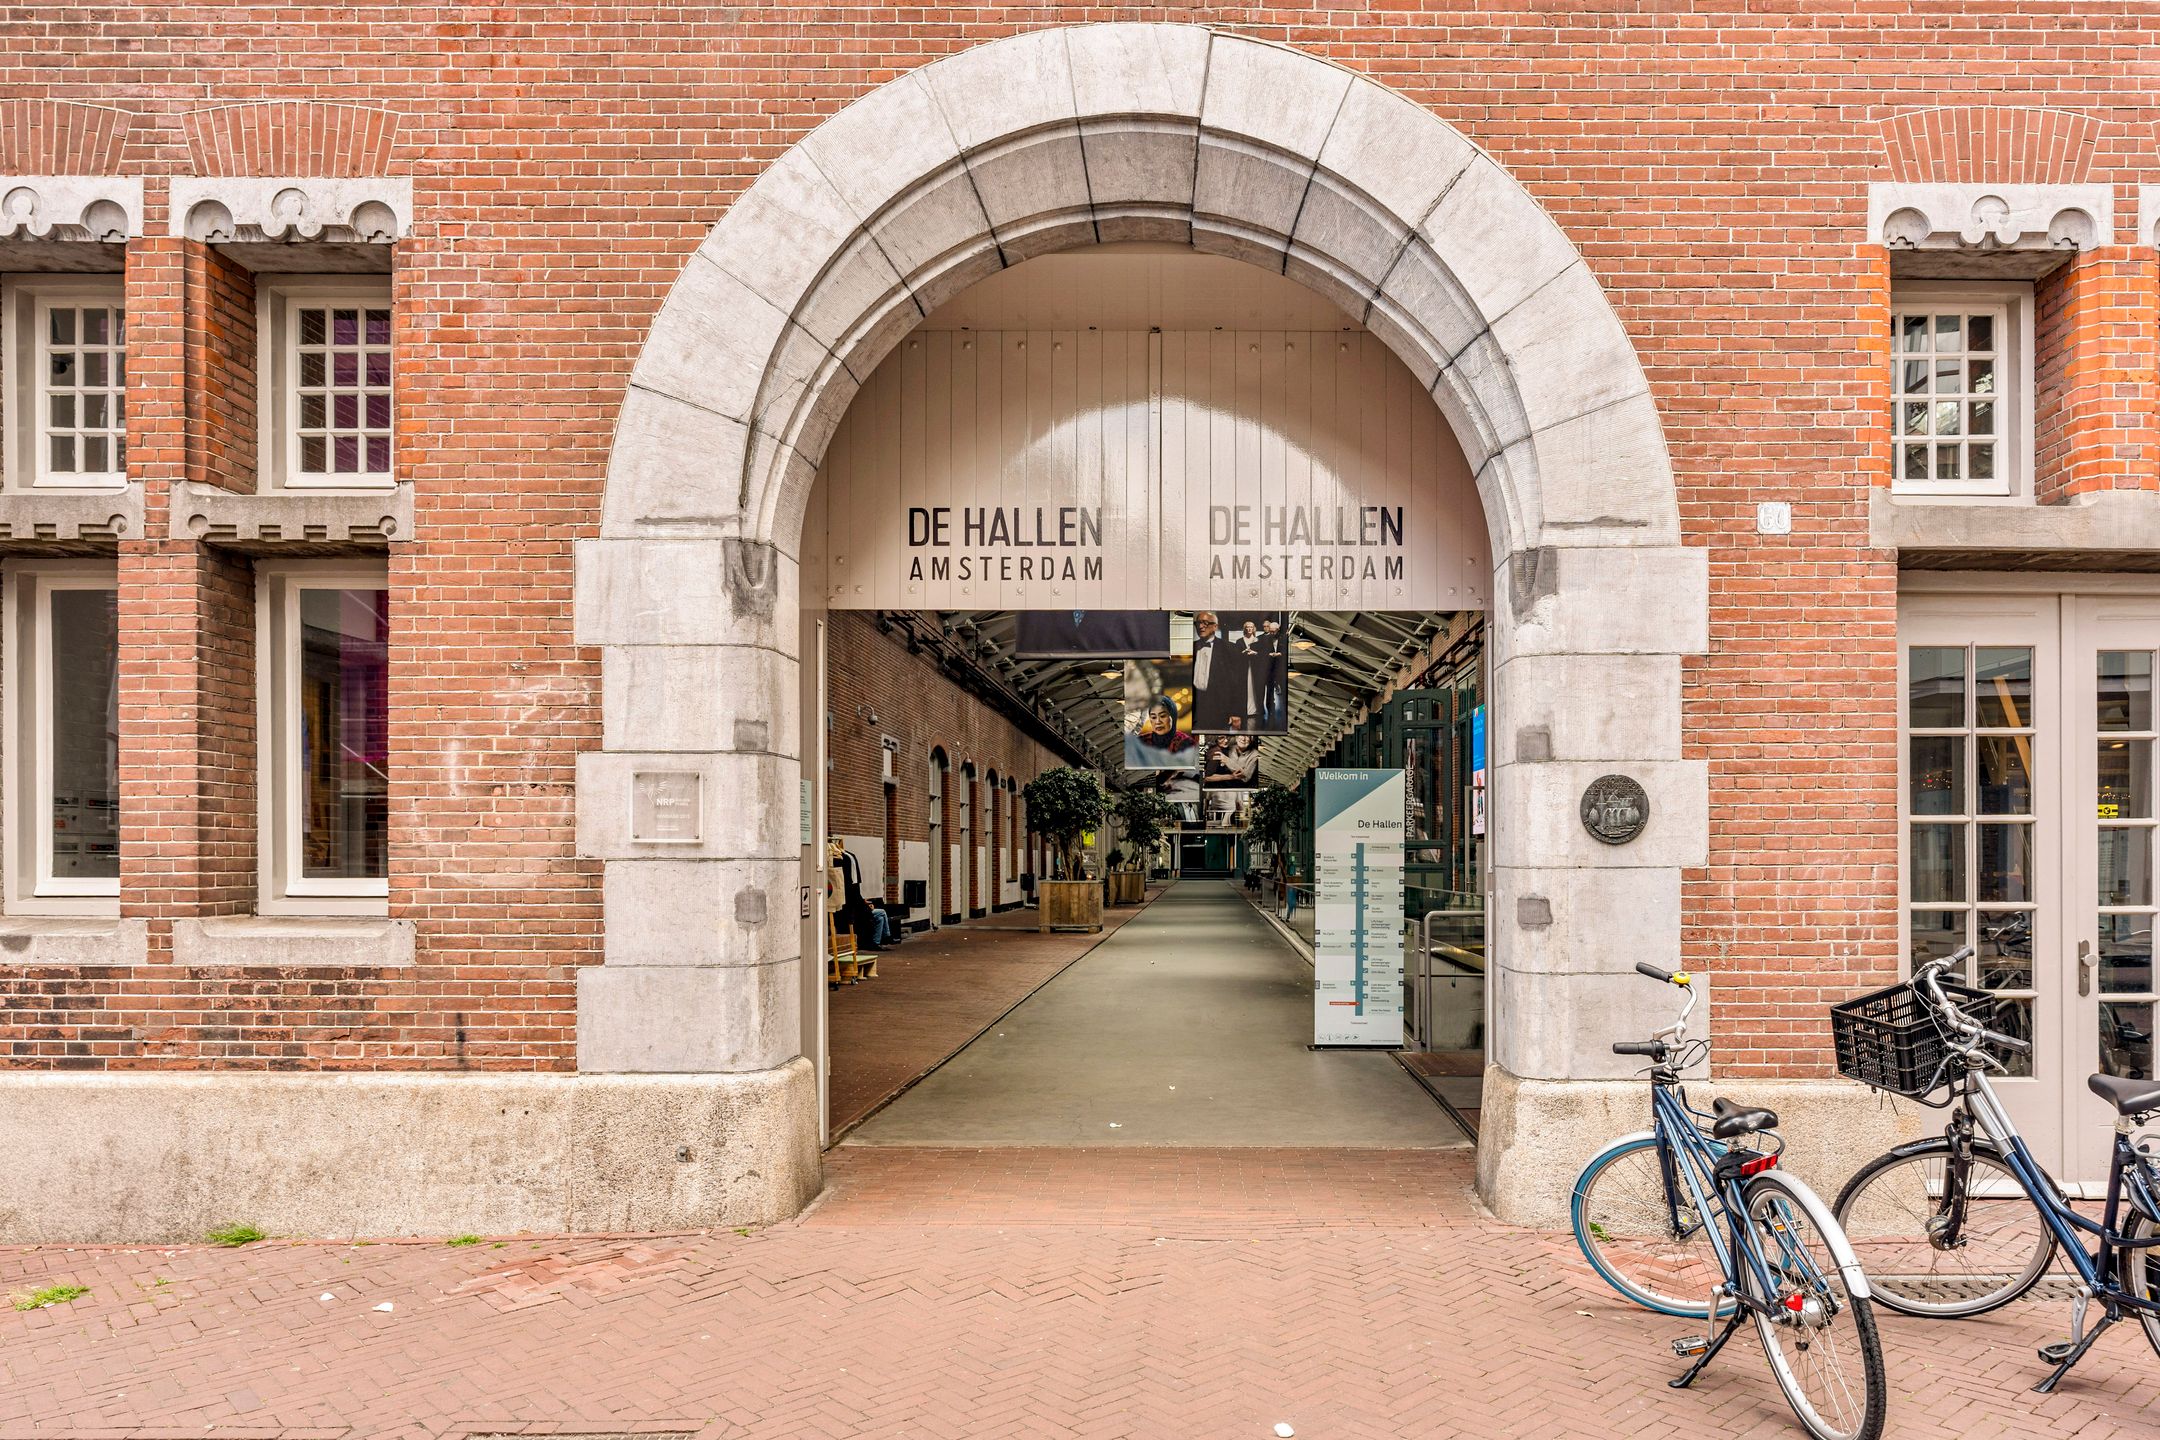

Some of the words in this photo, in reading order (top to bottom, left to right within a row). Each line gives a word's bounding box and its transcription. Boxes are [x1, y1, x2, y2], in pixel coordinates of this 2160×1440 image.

[909, 507, 951, 547] DE
[964, 506, 1101, 547] HALLEN
[1210, 505, 1251, 546] DE
[1265, 505, 1403, 546] HALLEN
[909, 556, 1102, 581] AMSTERDAM
[1209, 555, 1403, 580] AMSTERDAM
[1319, 771, 1358, 781] Welkom
[1360, 771, 1368, 780] in
[656, 798, 675, 806] NRP
[1358, 820, 1371, 829] De
[1373, 820, 1402, 829] Hallen
